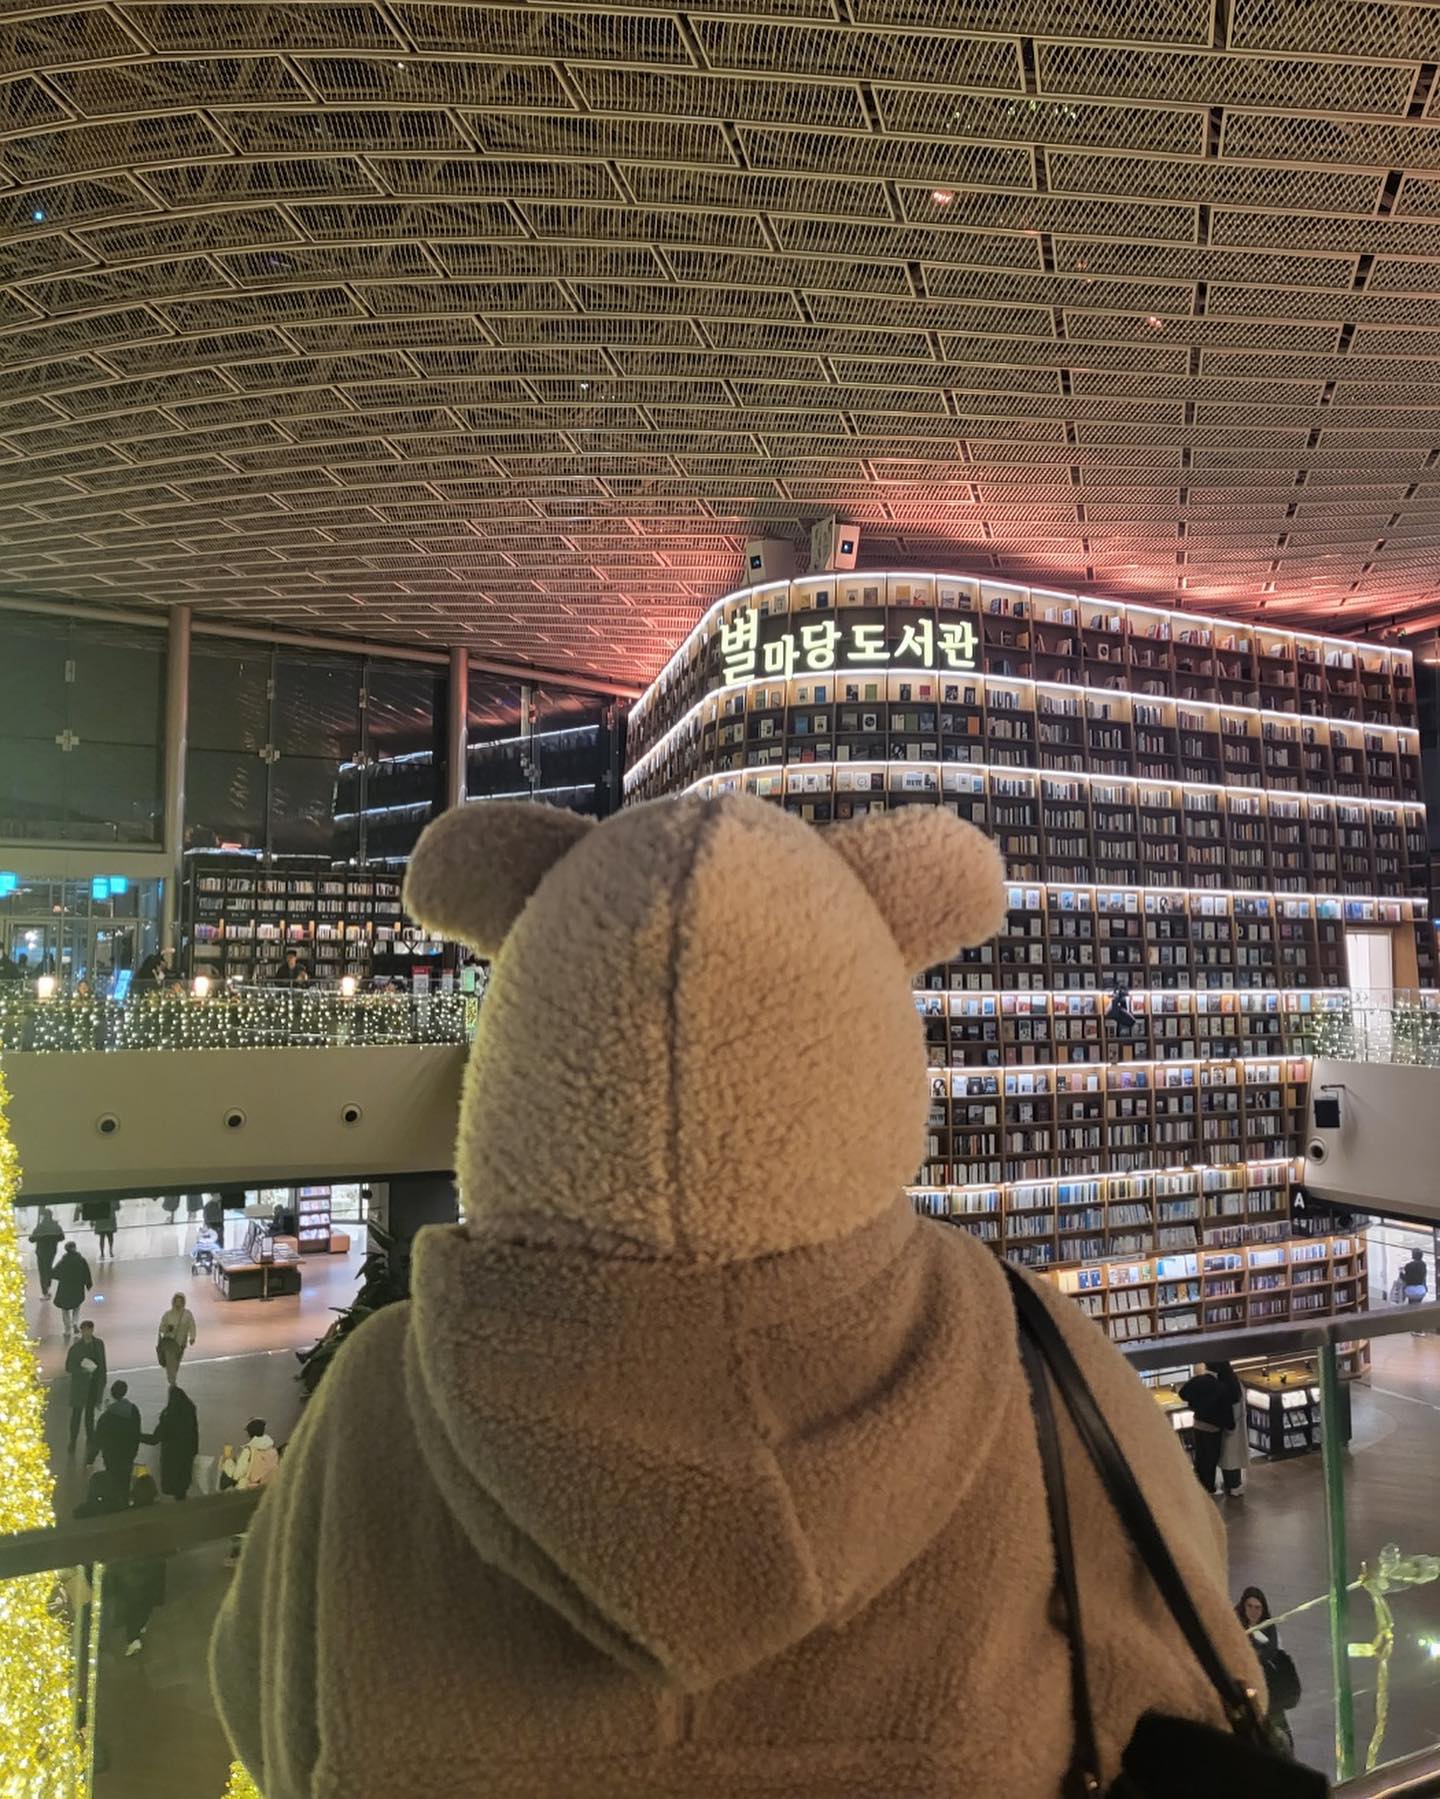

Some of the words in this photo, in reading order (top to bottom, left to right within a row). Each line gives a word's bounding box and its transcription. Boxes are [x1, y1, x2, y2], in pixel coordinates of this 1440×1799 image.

[719, 608, 842, 686] 별마당
[847, 618, 979, 668] 도서관
[1293, 1191, 1306, 1209] A
